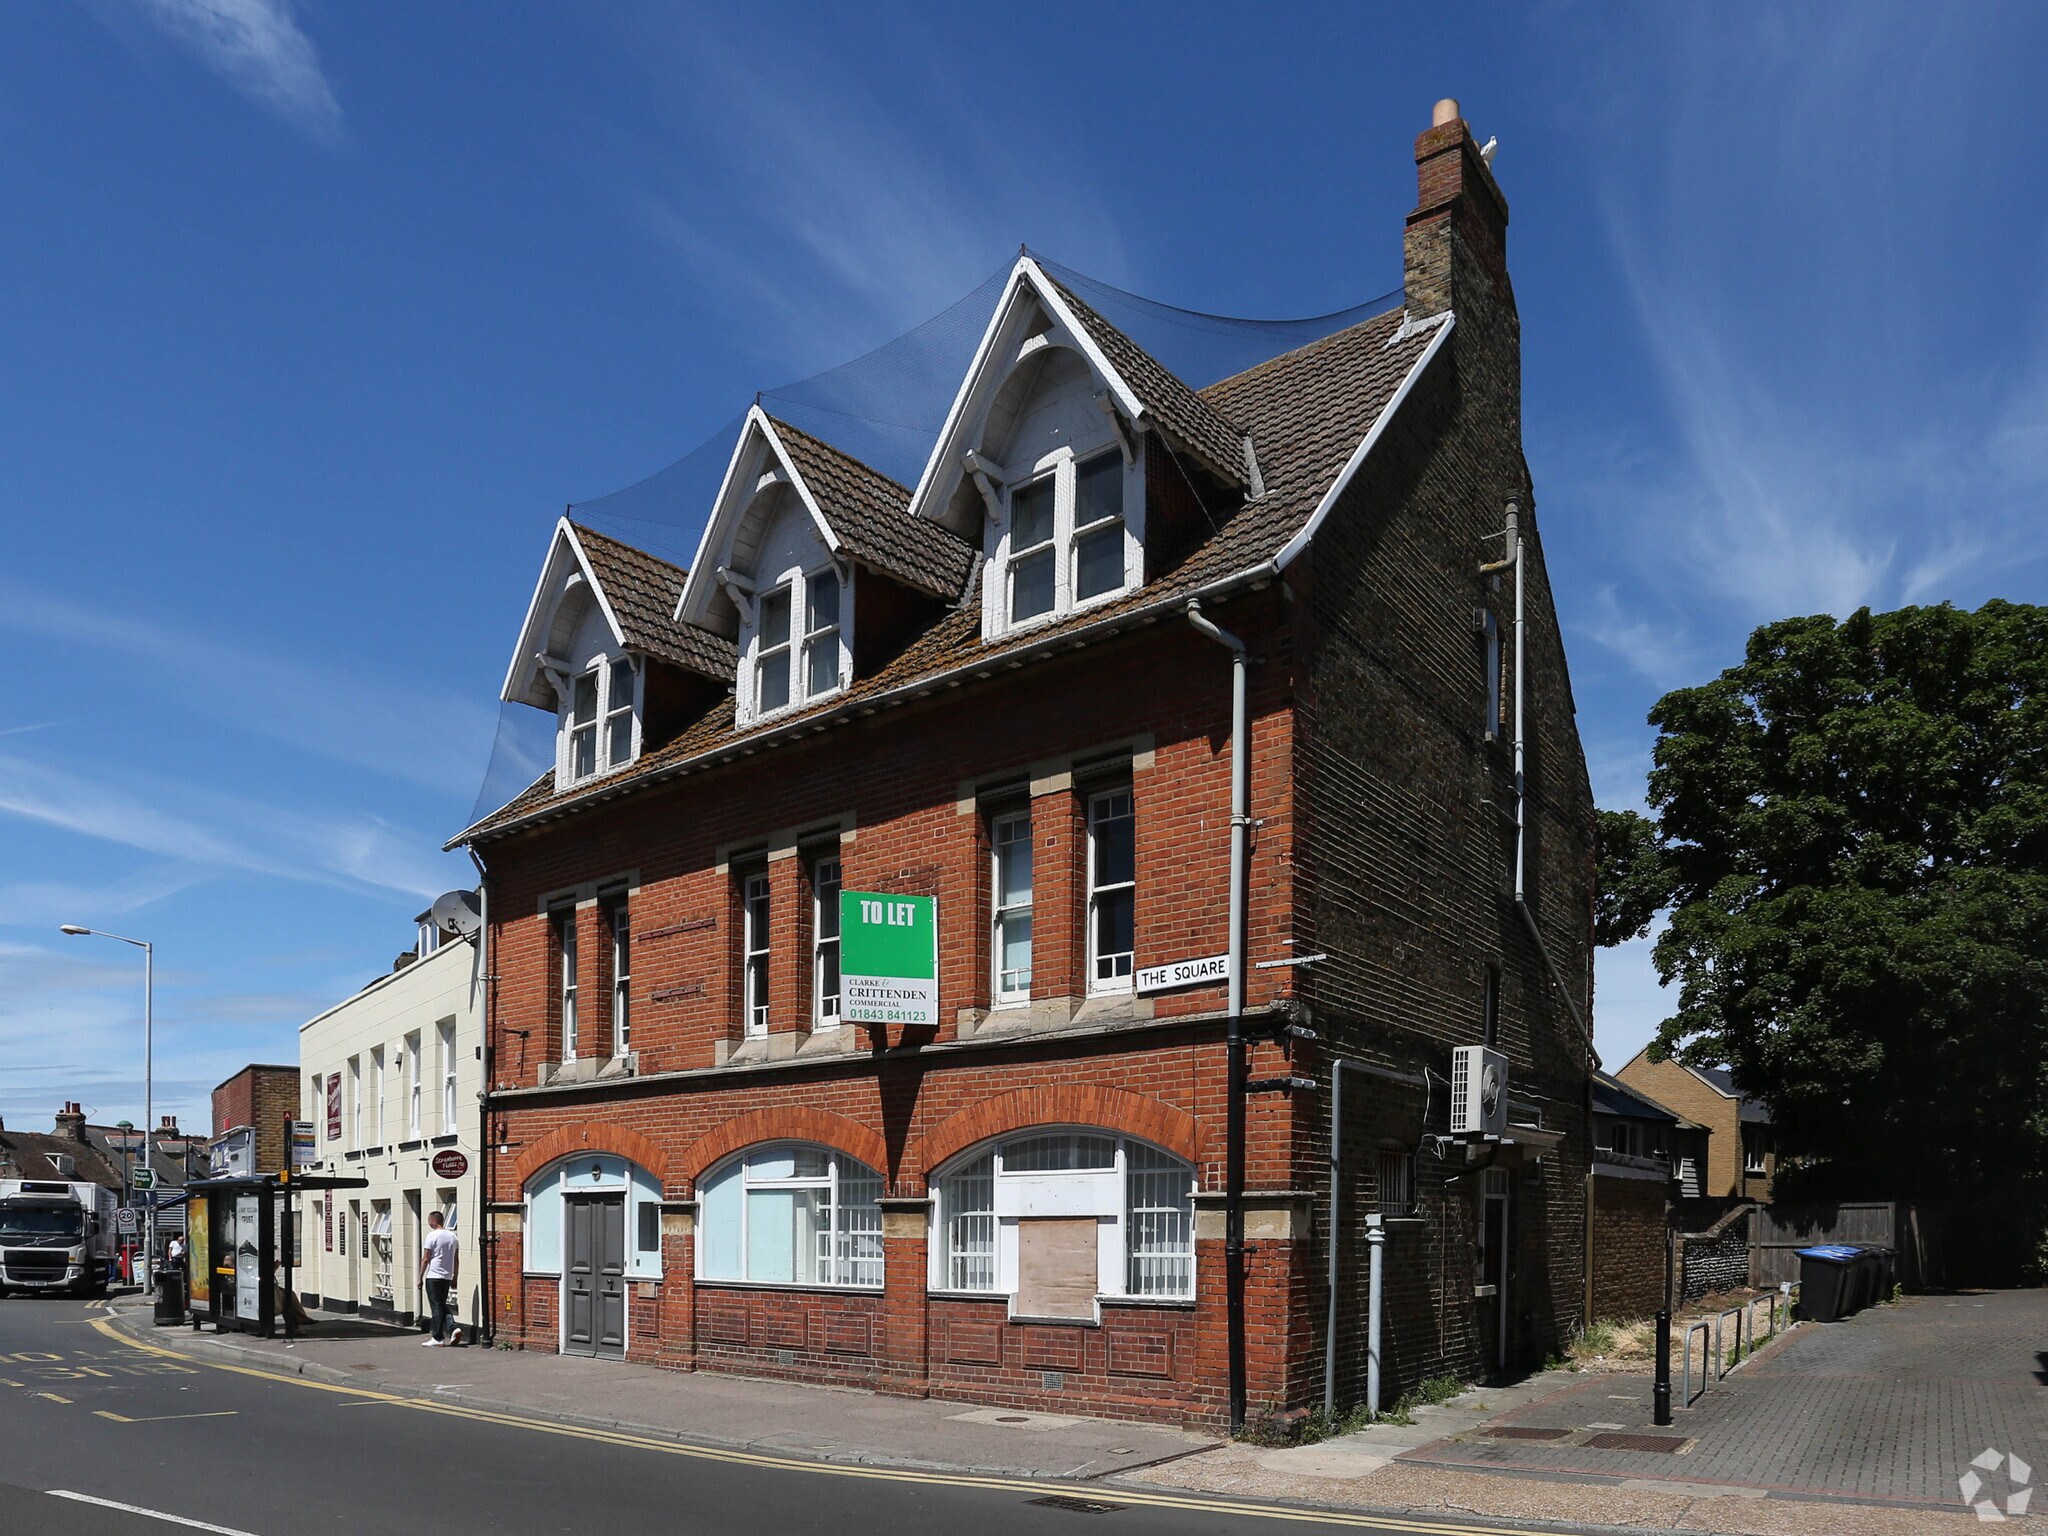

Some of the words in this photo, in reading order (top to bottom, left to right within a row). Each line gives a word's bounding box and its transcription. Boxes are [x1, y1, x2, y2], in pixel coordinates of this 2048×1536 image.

[860, 900, 883, 924] TO
[887, 902, 916, 926] LET
[1142, 970, 1167, 986] THE
[1174, 960, 1226, 981] SQUARE
[849, 979, 880, 987] CLARKE
[849, 987, 928, 1000] CRITTENDEN
[849, 999, 902, 1007] COMMERCIAL
[850, 1008, 884, 1020] 01843
[887, 1010, 927, 1021] 841123
